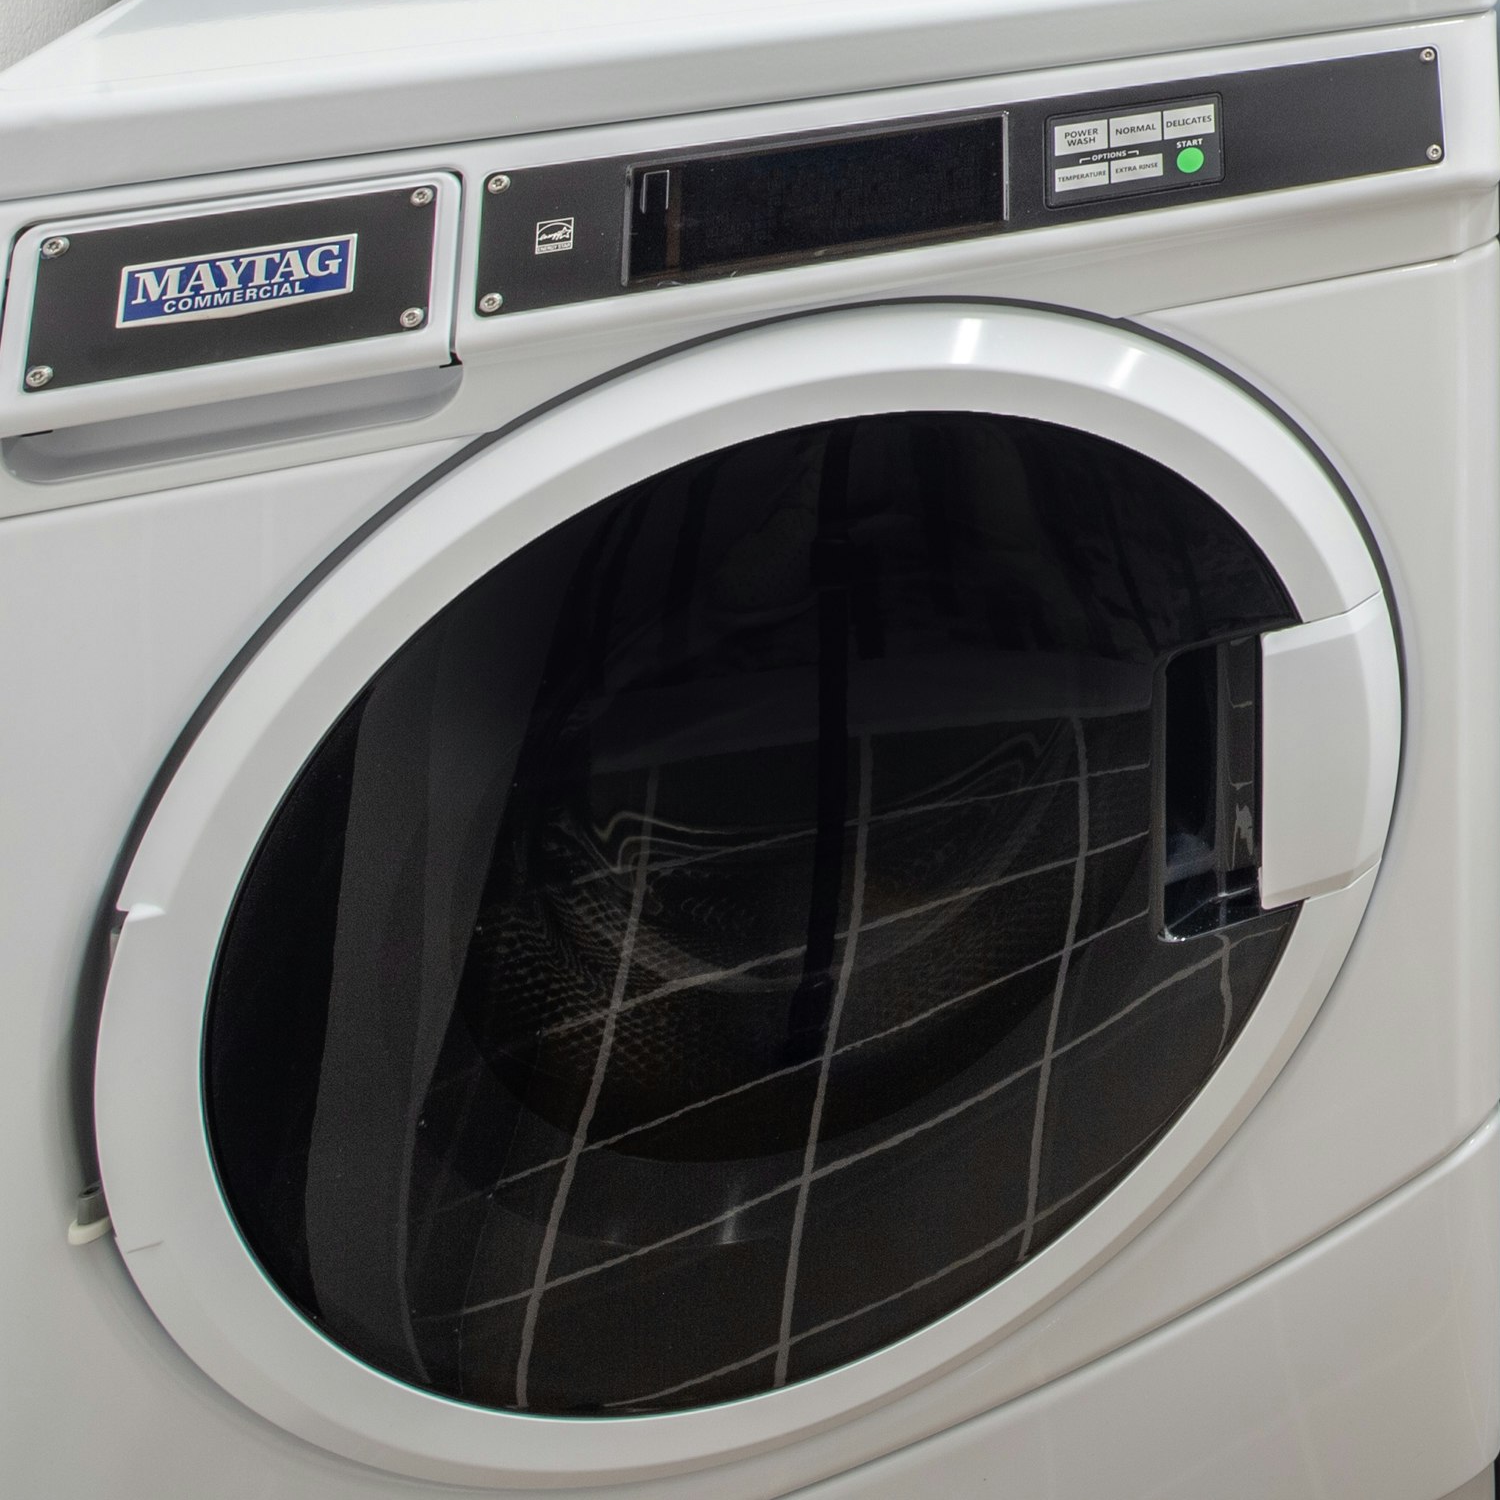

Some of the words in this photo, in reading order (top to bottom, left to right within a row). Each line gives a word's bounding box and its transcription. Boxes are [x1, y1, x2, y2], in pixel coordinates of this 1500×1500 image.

[1166, 115, 1213, 129] DELICATES
[1064, 128, 1099, 139] POWER
[1115, 123, 1157, 136] NORMAL
[1067, 136, 1097, 147] WASH
[1176, 138, 1204, 149] START
[1091, 150, 1127, 162] OPTIONS
[1115, 165, 1138, 174] EXTRA
[1139, 162, 1159, 171] RINSE
[1057, 170, 1107, 183] TEMPERATURE
[131, 244, 343, 305] MAYTAG
[163, 282, 305, 314] COMMERCIAL
